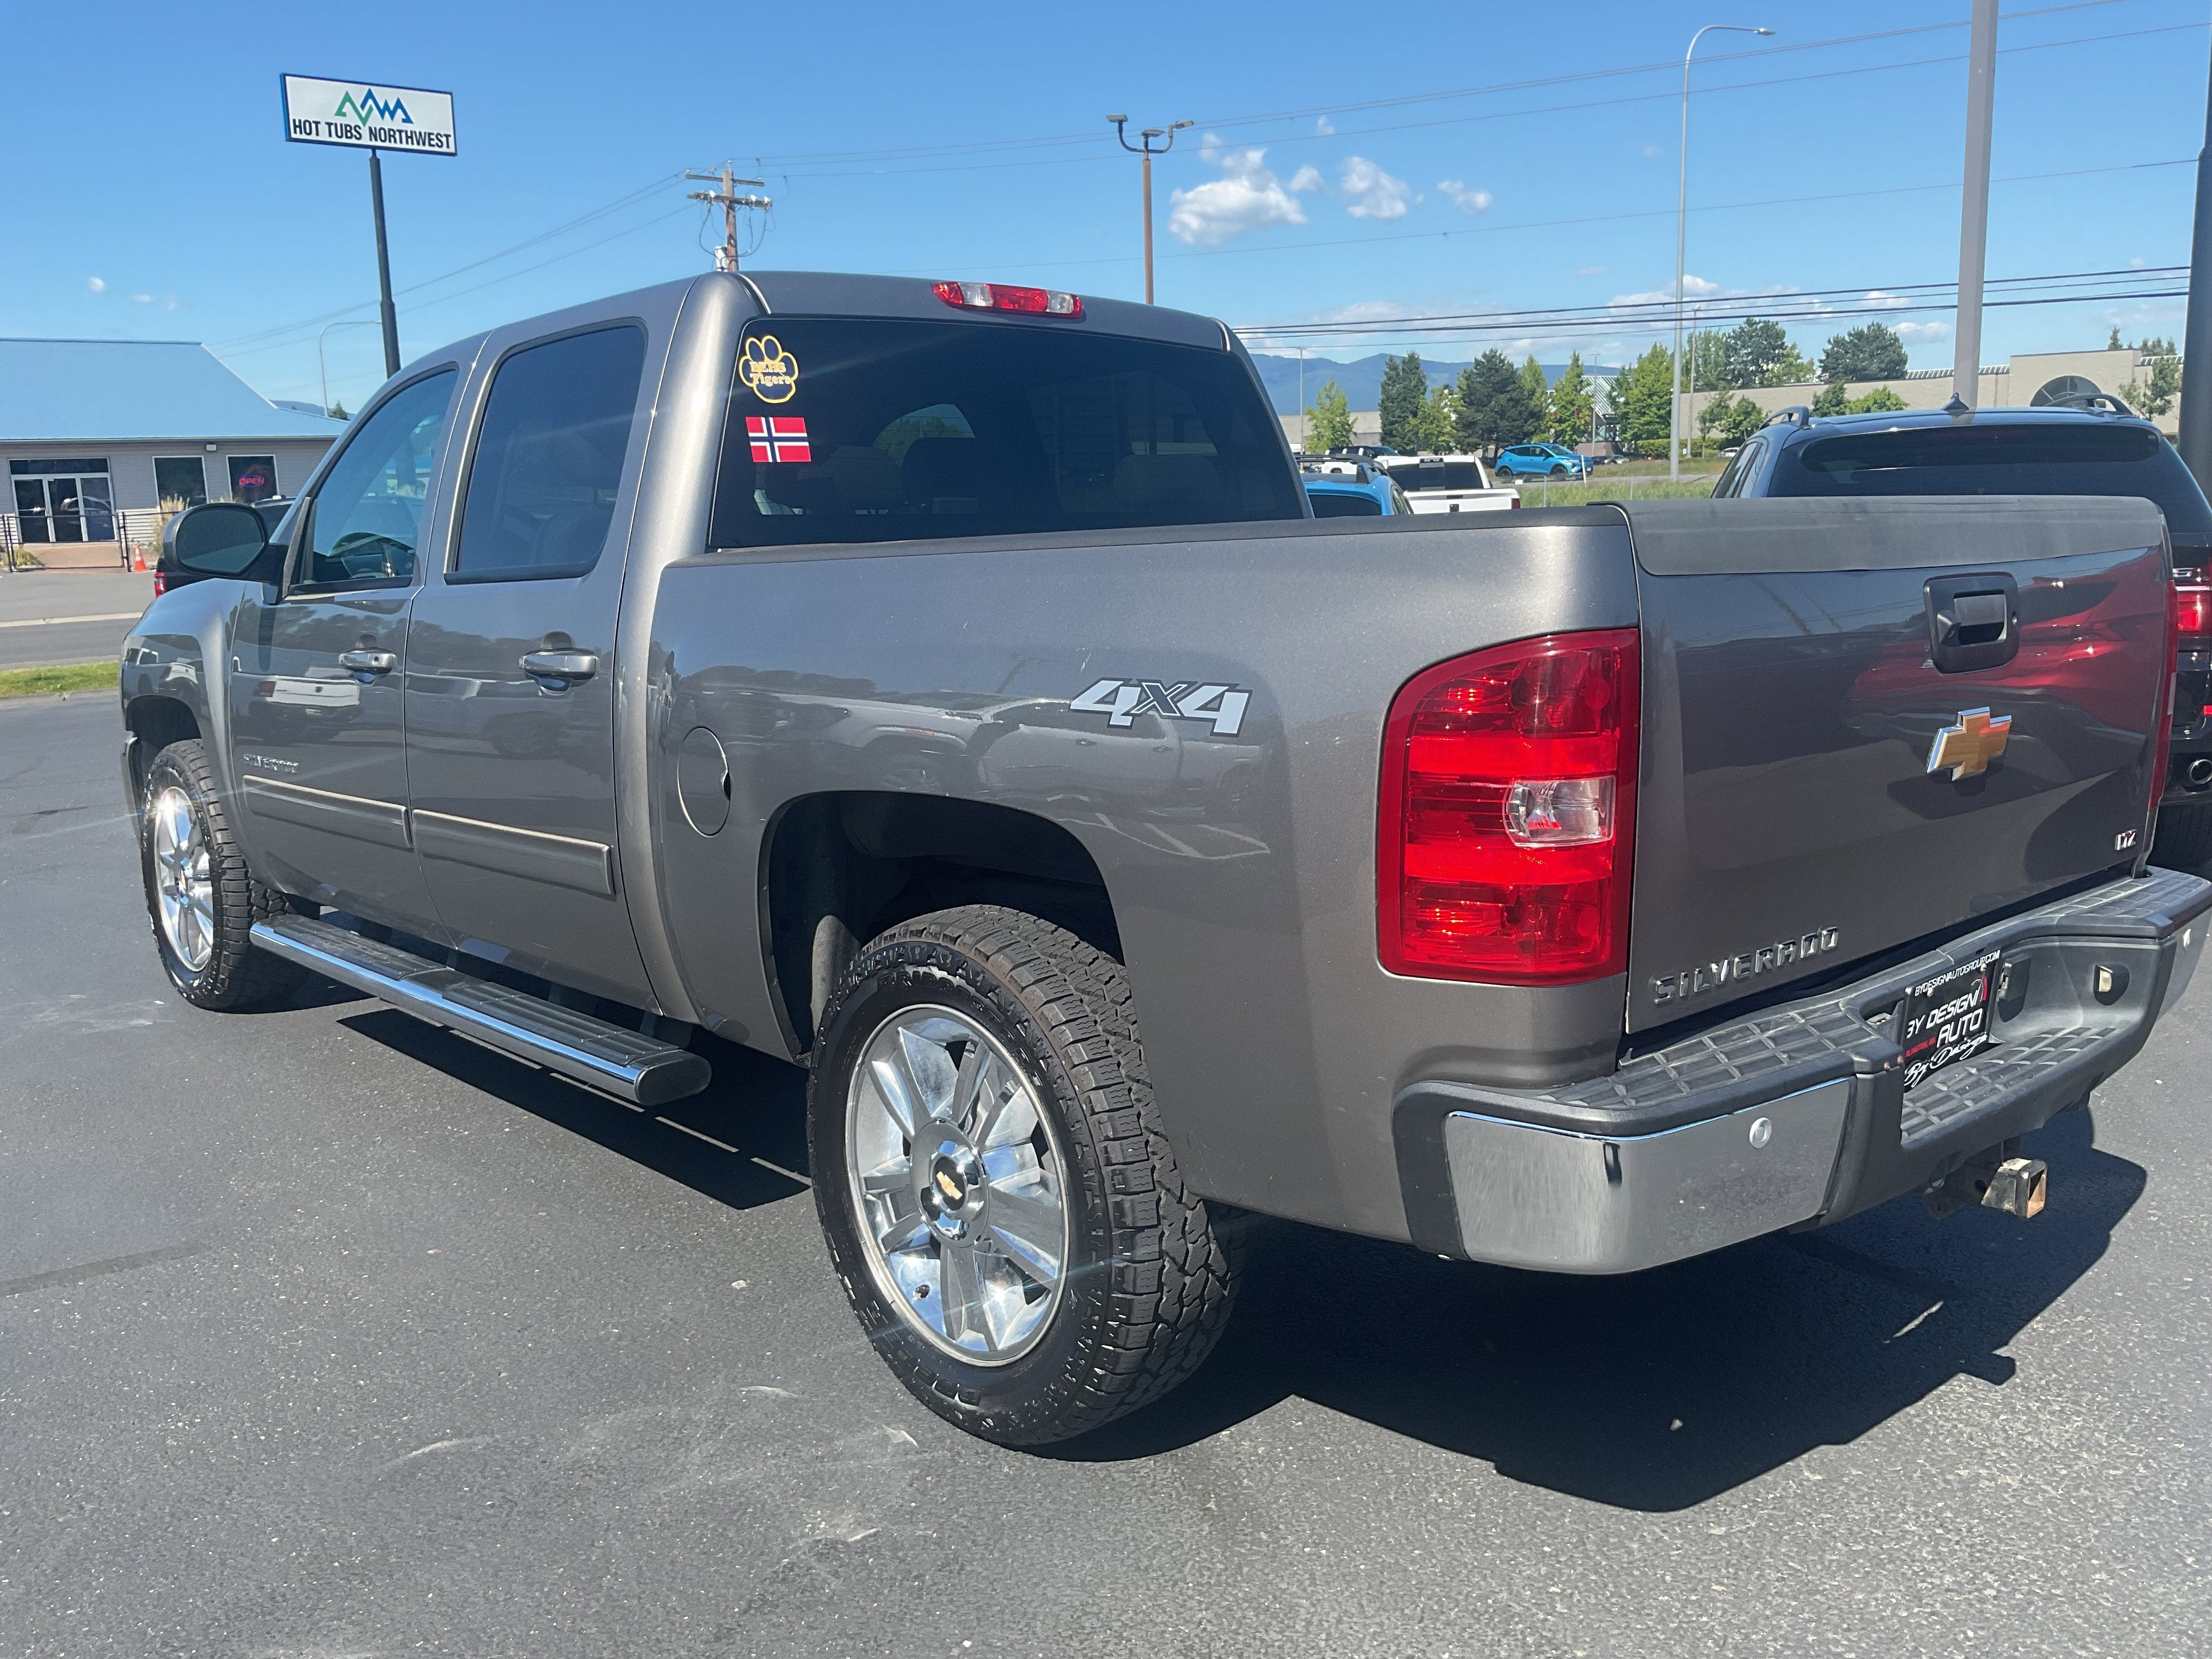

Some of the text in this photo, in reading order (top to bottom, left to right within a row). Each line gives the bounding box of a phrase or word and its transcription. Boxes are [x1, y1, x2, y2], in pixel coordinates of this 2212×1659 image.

[292, 119, 452, 149] HOT TUBS NORTHWEST
[749, 373, 791, 386] Tigers
[239, 477, 264, 486] OPEN
[1654, 926, 1839, 1005] SILVERADO
[1915, 950, 2001, 997] BYDESIGNAUTOGROUPCOM
[1906, 994, 1977, 1039] BY DESIGN
[1937, 1008, 1983, 1048] AUTO
[1904, 1061, 1930, 1088] By
[1930, 1032, 1988, 1069] Design
